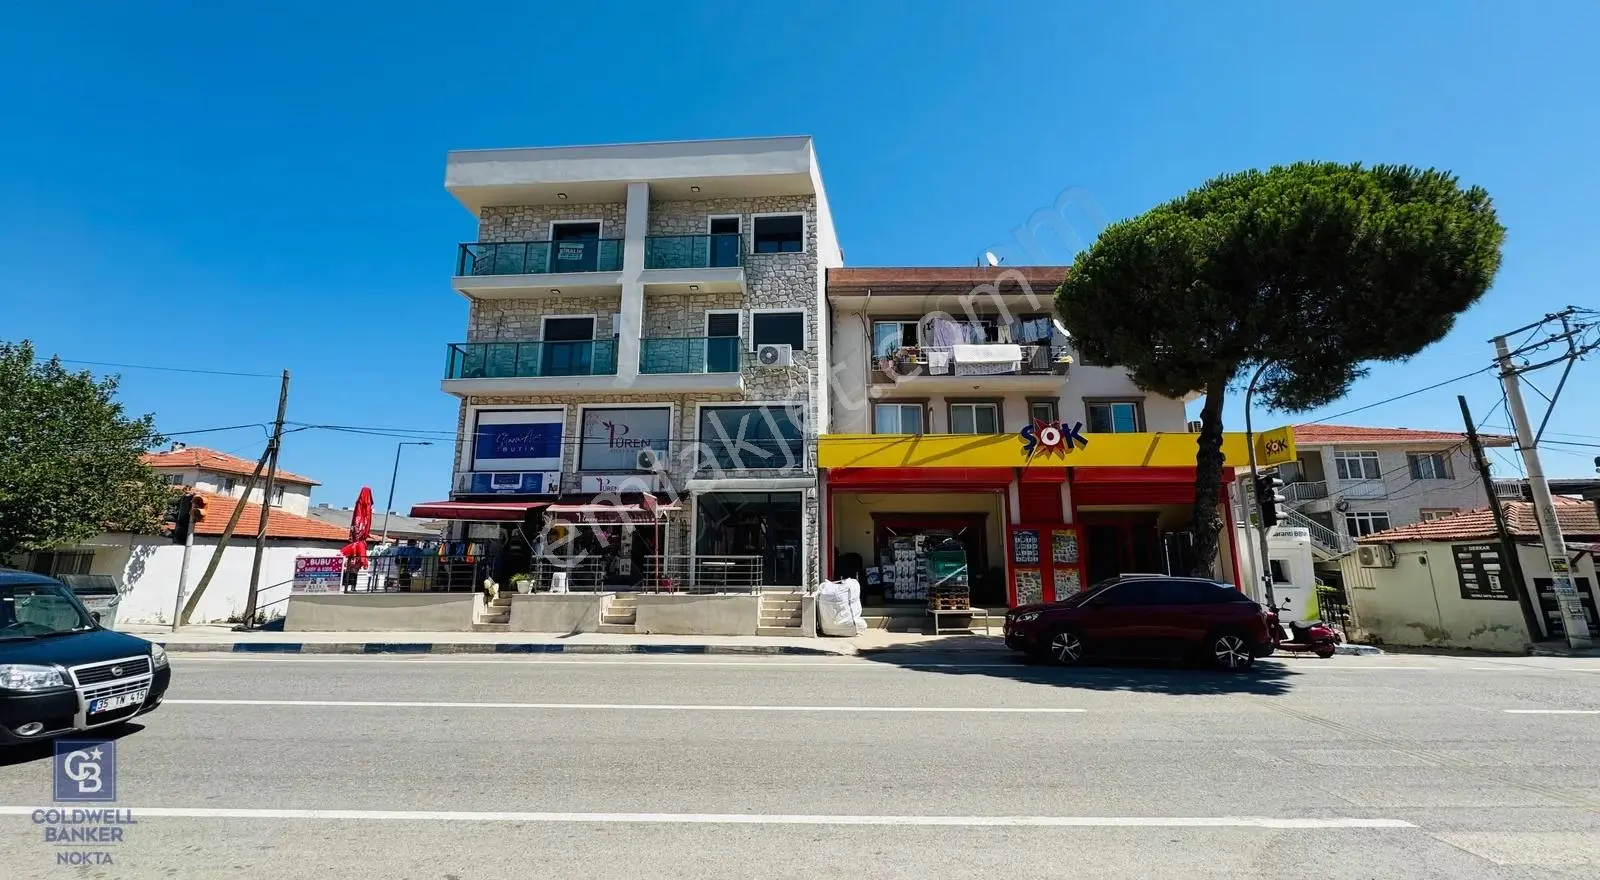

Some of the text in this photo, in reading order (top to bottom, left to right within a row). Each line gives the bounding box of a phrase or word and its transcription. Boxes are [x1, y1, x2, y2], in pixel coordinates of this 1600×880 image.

[606, 421, 652, 449] PÜREN
[1020, 420, 1089, 457] ŞOK
[97, 690, 145, 709] 35 TN 415
